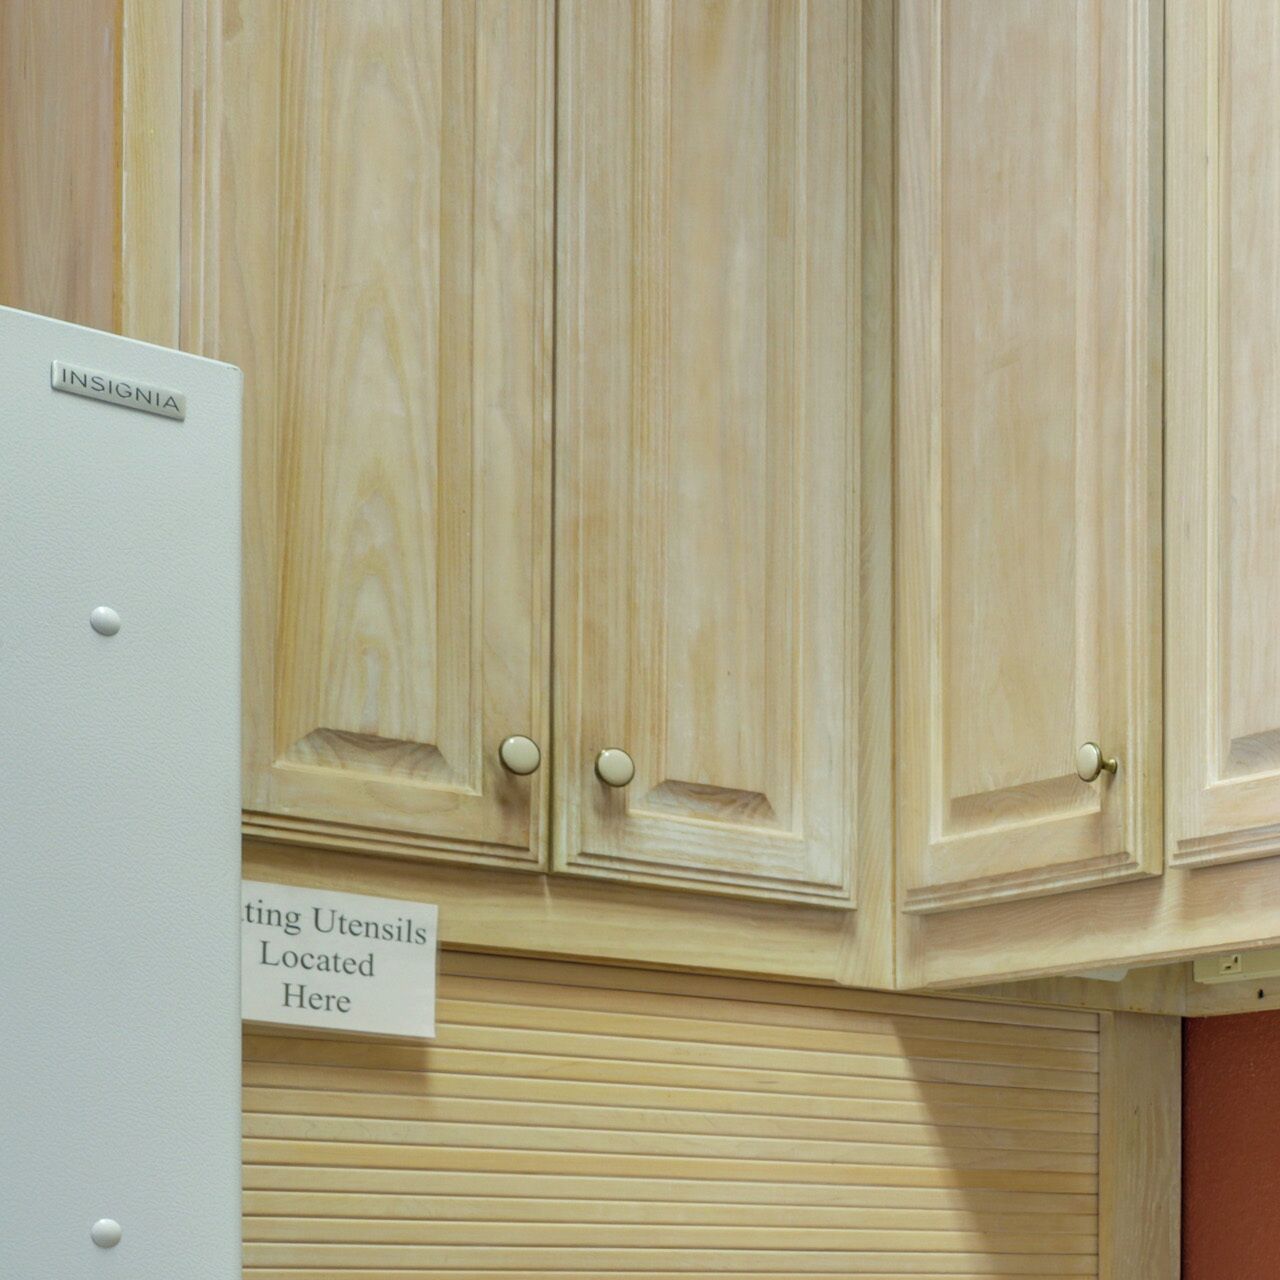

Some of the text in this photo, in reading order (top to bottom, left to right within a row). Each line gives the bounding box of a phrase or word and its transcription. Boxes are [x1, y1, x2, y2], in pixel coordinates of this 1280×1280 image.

[62, 367, 180, 412] INSIGNIA
[241, 899, 428, 945] ting Utensils
[259, 940, 375, 977] Located
[281, 982, 352, 1013] Here
